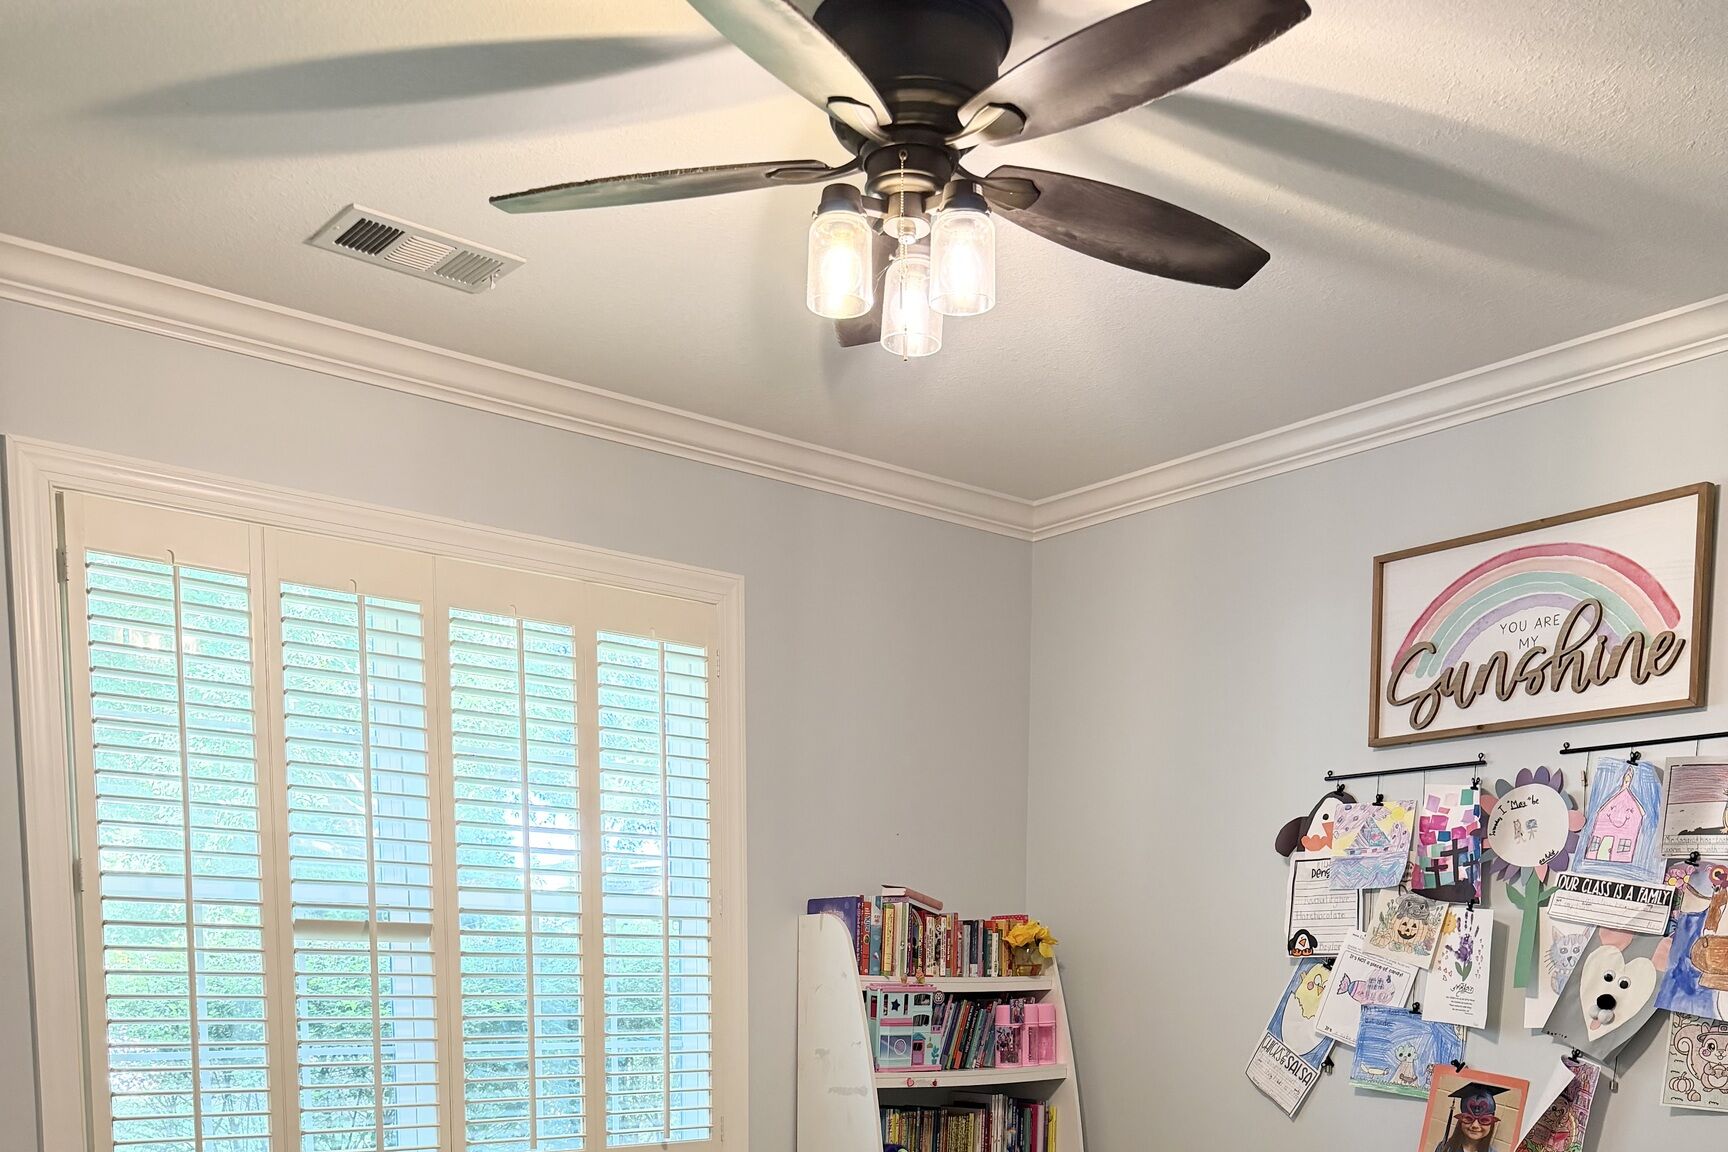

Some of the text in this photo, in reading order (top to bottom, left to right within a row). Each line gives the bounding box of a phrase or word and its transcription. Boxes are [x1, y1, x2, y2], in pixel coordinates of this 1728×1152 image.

[1500, 614, 1560, 635] YOU ARE
[1519, 636, 1539, 650] MY
[1387, 598, 1687, 730] Sunshine
[1558, 875, 1580, 891] OUR
[1581, 879, 1612, 897] CLASS
[1614, 883, 1625, 899] IS
[1625, 886, 1634, 901] A
[1284, 1055, 1313, 1086] SALSA
